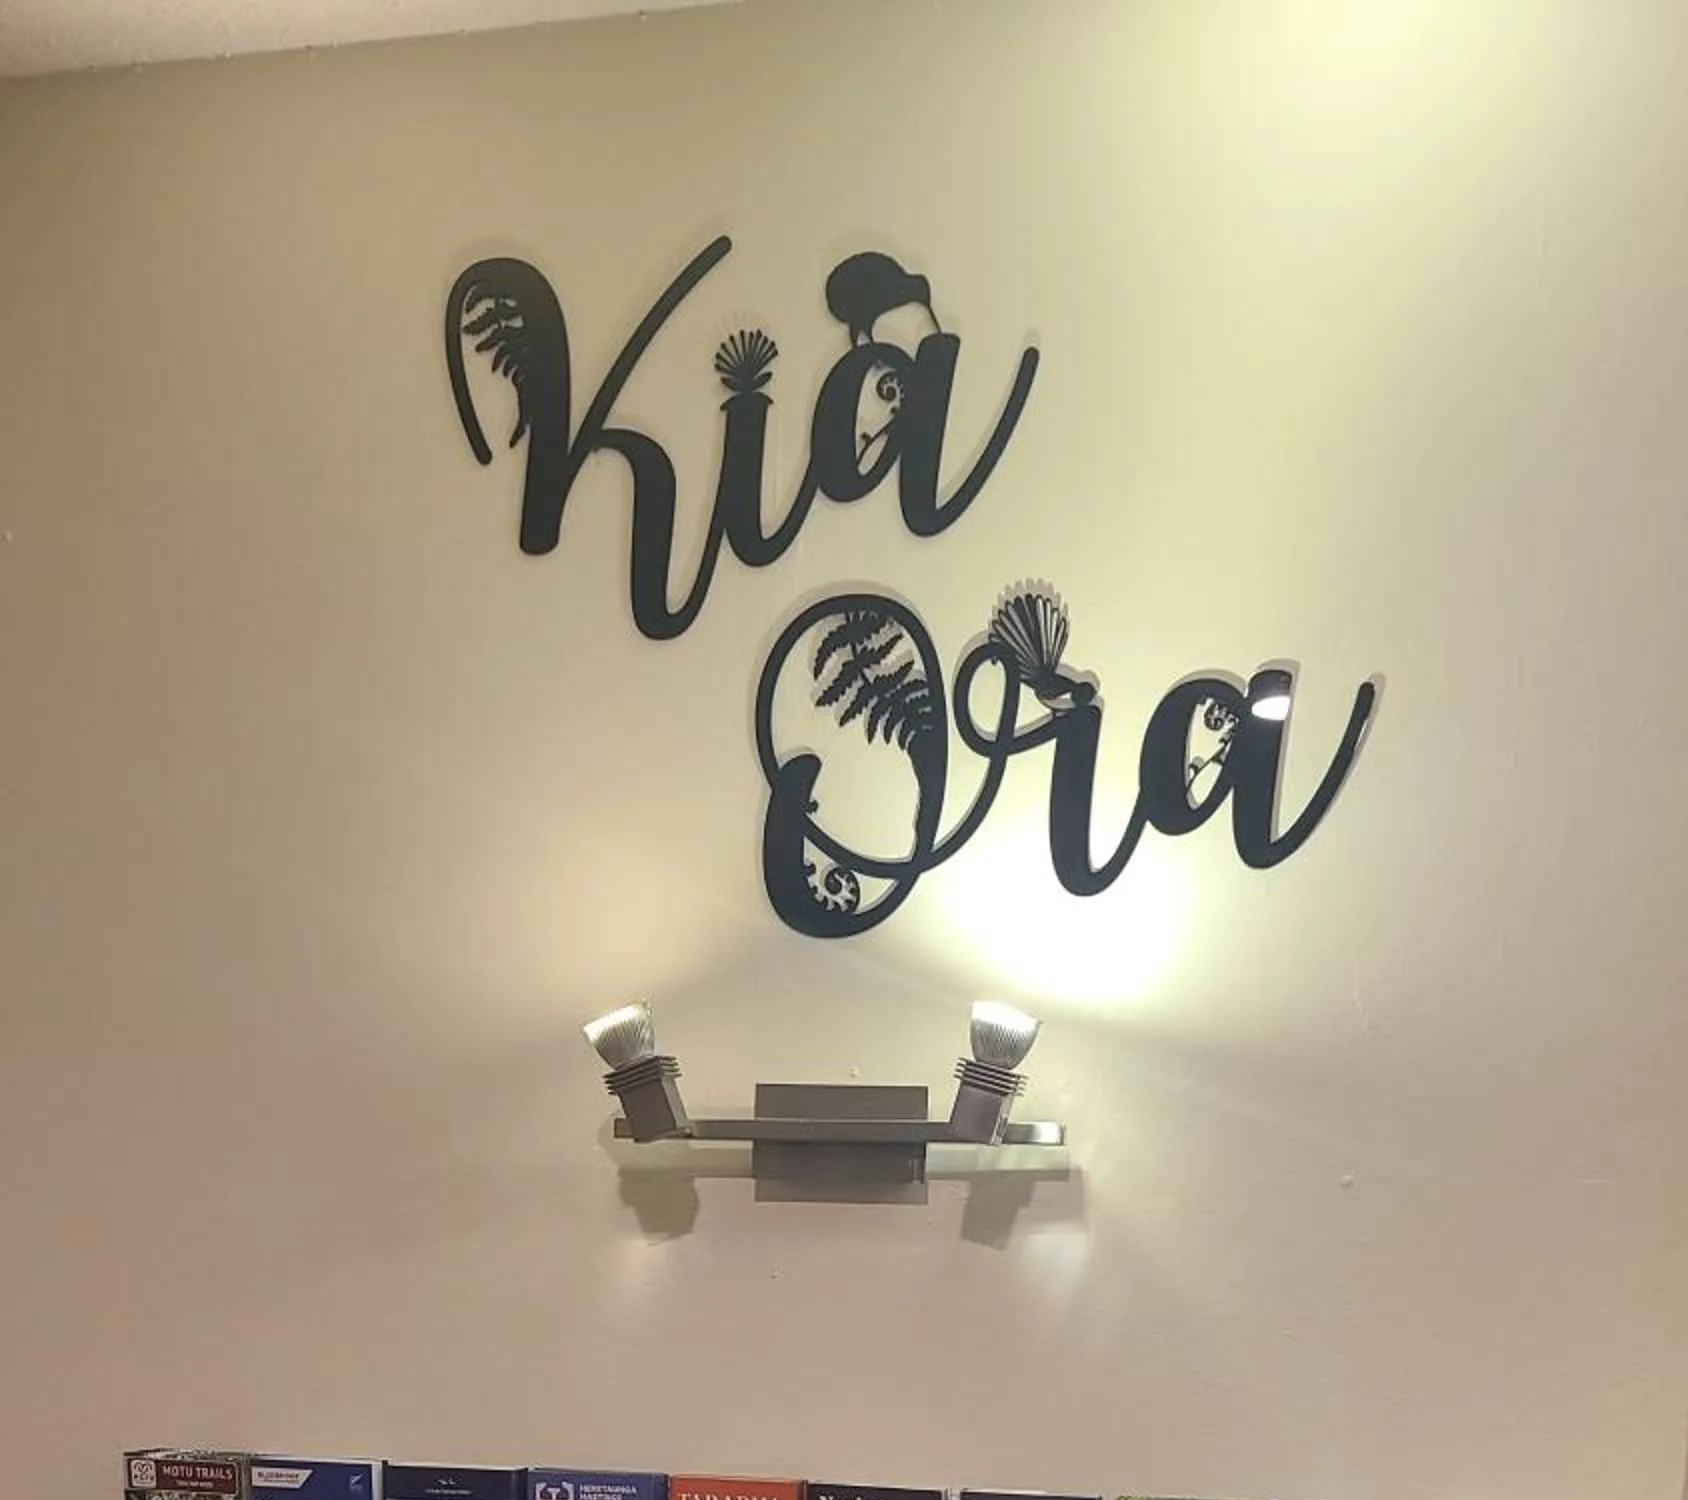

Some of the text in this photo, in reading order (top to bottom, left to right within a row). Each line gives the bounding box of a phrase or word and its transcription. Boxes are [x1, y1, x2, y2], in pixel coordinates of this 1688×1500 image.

[445, 235, 1040, 640] Kia
[755, 592, 1375, 939] Ora
[162, 1466, 233, 1480] MOTU TRAILS
